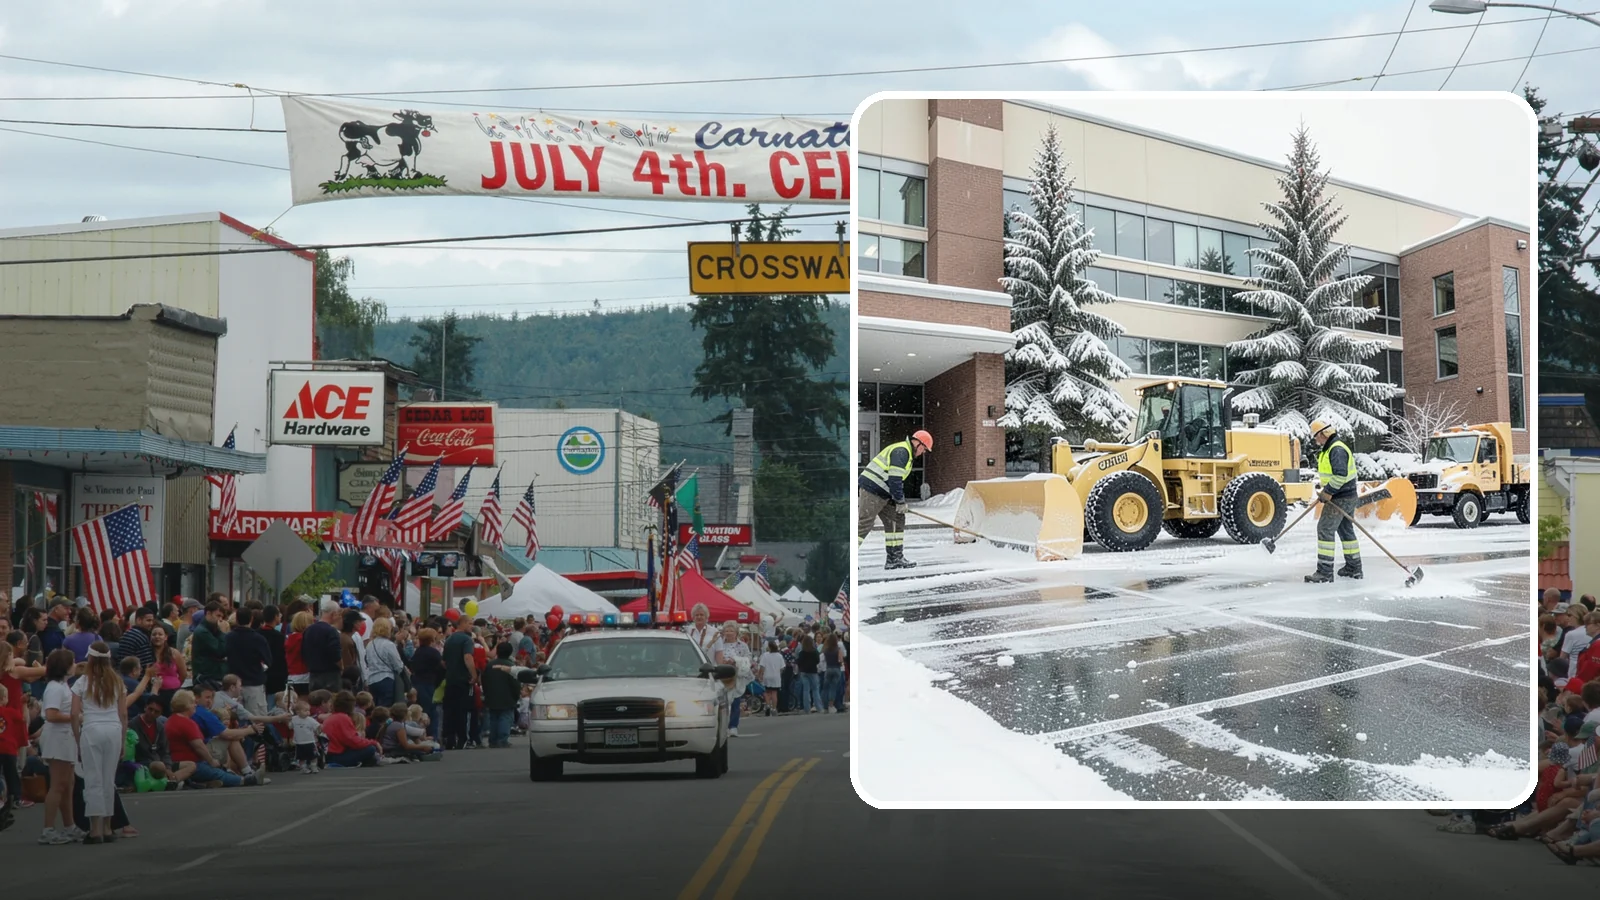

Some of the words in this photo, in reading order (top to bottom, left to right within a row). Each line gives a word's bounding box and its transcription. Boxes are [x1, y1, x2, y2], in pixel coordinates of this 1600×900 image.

[481, 141, 605, 192] JULY
[632, 150, 746, 198] 4th.
[697, 254, 850, 280] CROSSWA
[283, 380, 373, 420] ACE
[406, 409, 453, 422] CEDAR
[461, 409, 485, 422] LOG
[283, 421, 371, 437] Hardware
[416, 428, 477, 447] Coca-Cola
[353, 467, 385, 480] Simpl
[95, 485, 124, 495] Vincent
[126, 486, 136, 495] de
[137, 486, 155, 495] Paul
[81, 503, 154, 522] THRT
[213, 516, 331, 536] HARDARE
[688, 526, 741, 535] CRNATION
[699, 535, 730, 543] GLASS
